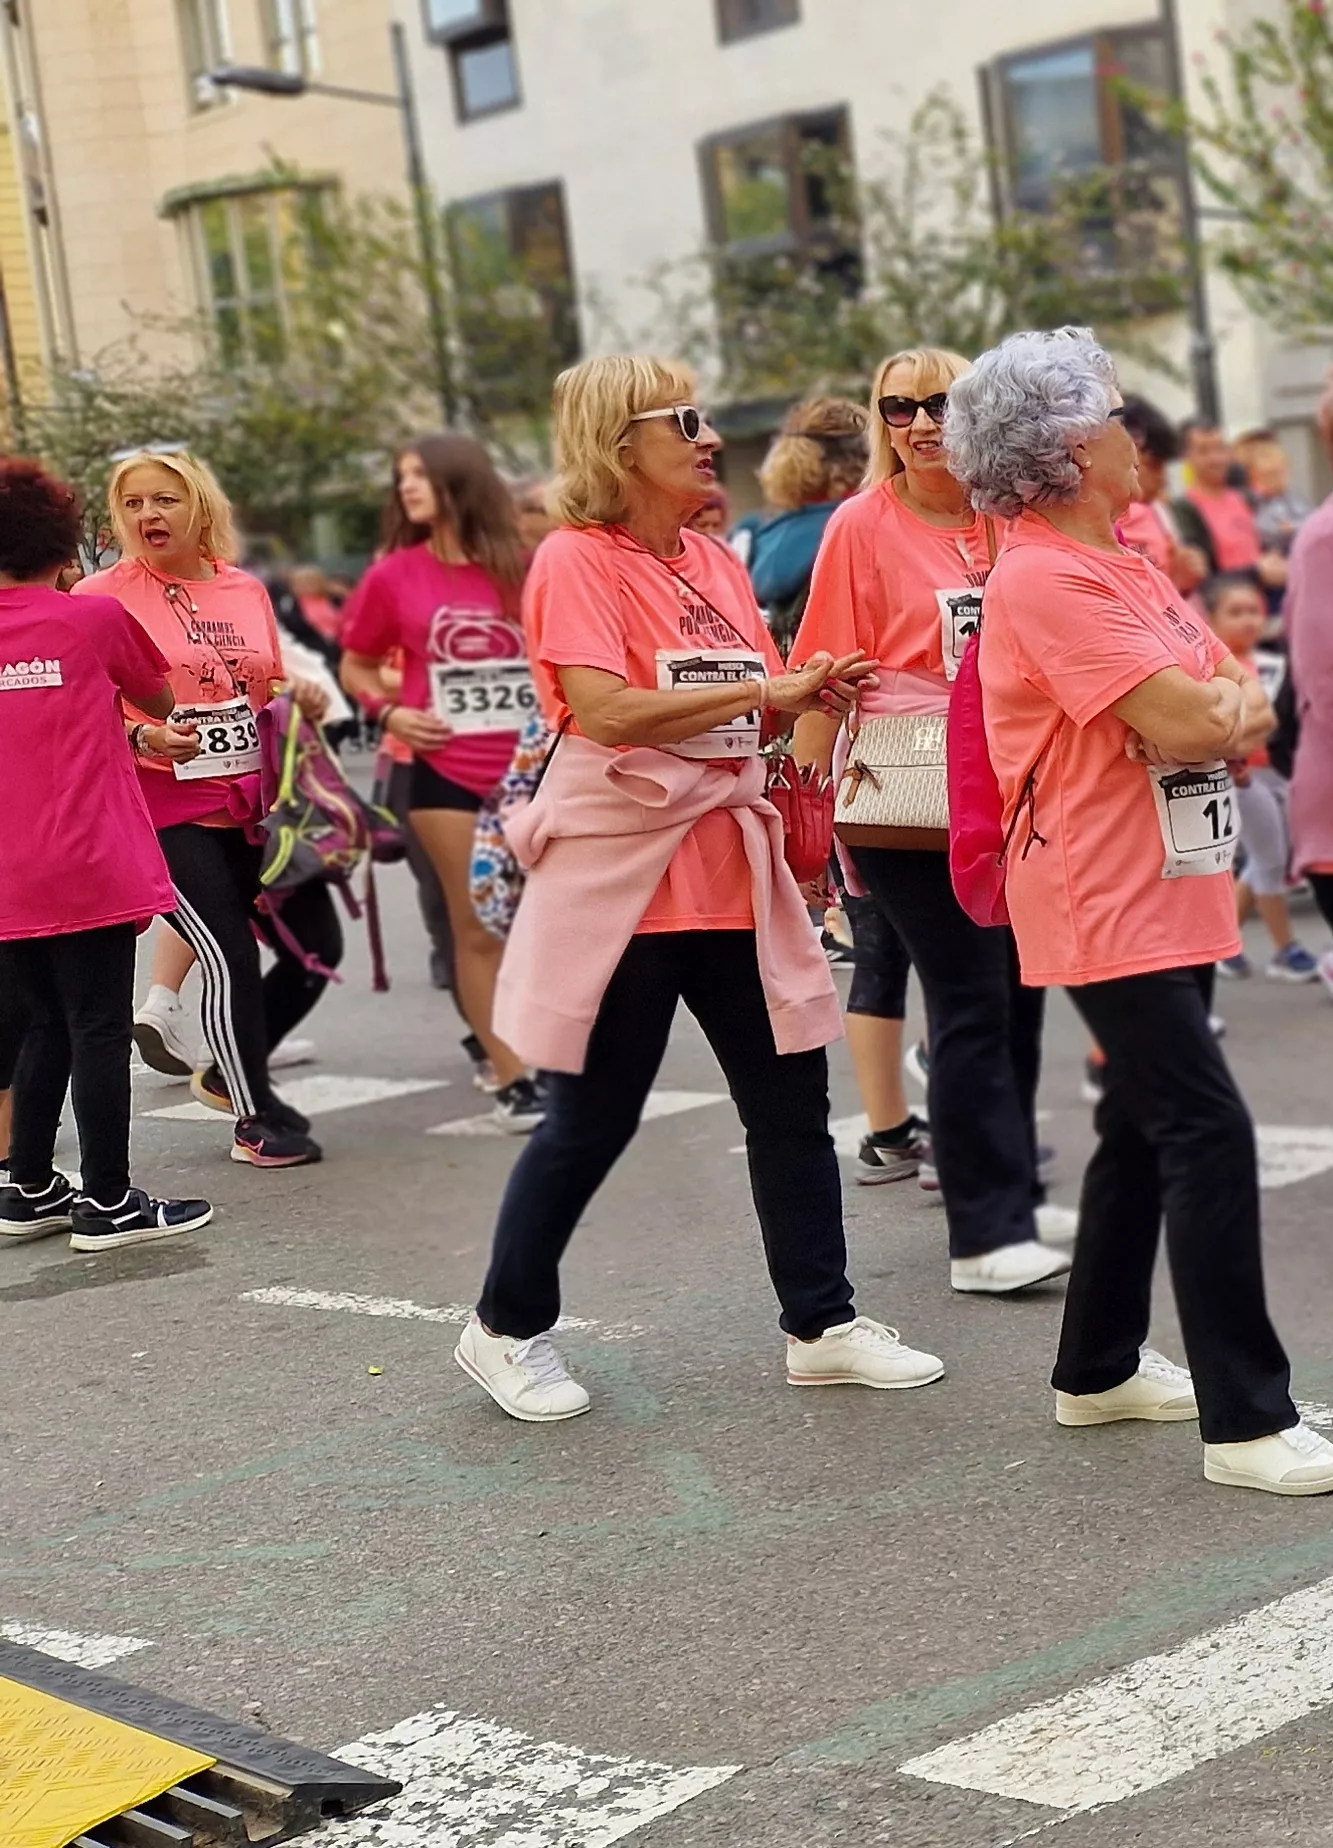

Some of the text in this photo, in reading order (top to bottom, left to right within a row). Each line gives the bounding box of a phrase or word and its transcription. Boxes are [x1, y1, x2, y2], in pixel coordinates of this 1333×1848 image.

[680, 670, 725, 681] CONTRA
[726, 672, 738, 681] EL
[447, 683, 536, 714] 3326
[1172, 782, 1215, 797] CONTRA
